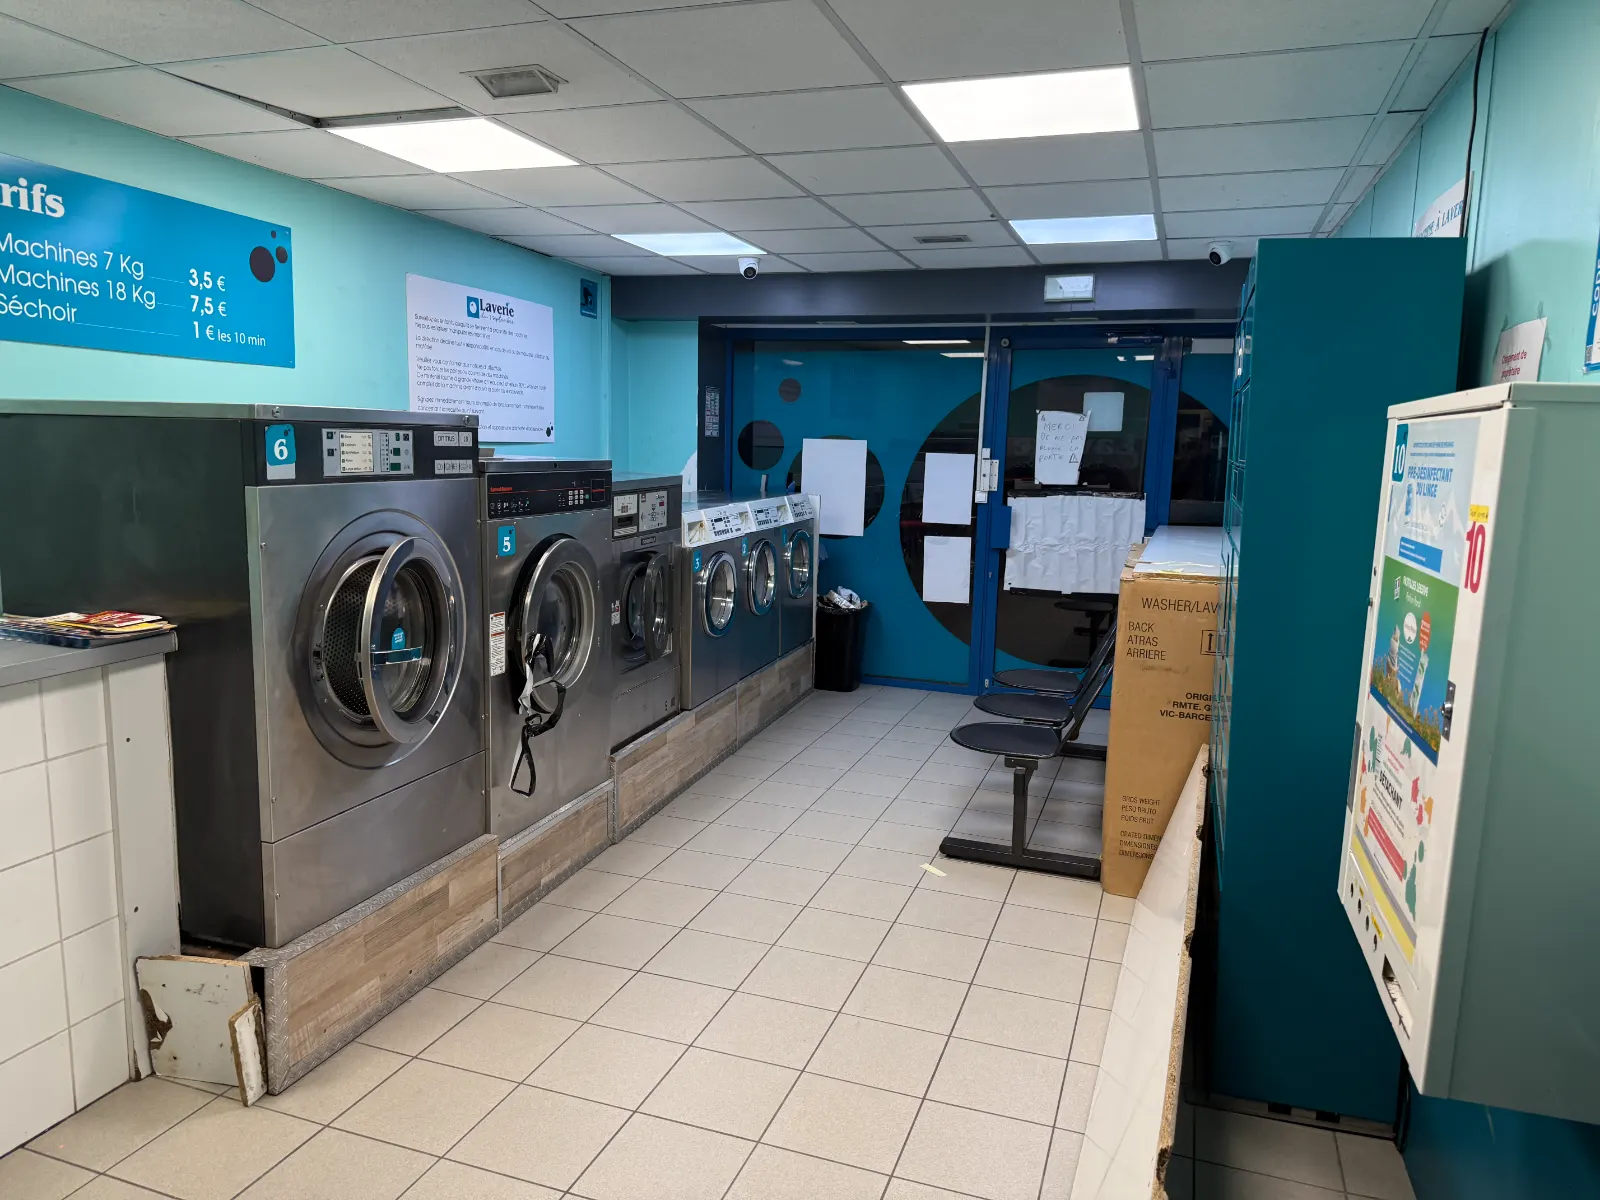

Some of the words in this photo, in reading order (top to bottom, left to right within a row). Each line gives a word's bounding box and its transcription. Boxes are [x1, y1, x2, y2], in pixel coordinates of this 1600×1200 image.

[0, 232, 98, 269] Machines
[103, 251, 113, 270] 7
[120, 255, 144, 281] Kg
[0, 264, 99, 297] Machines
[107, 280, 127, 302] 18
[132, 285, 156, 310] Kg
[188, 268, 213, 291] 3,5
[216, 276, 226, 292] €
[0, 293, 77, 324] Séchoir
[190, 294, 214, 316] 7,5
[218, 302, 227, 317] €
[480, 298, 515, 318] Laverie
[192, 321, 200, 339] 1
[206, 325, 215, 341] €
[217, 329, 232, 343] les
[234, 331, 246, 344] 10
[248, 334, 267, 347] min
[273, 438, 289, 460] 6
[1393, 443, 1406, 474] 10
[502, 537, 511, 552] 5
[1465, 520, 1486, 594] 10
[1128, 621, 1154, 633] BACK
[1127, 635, 1158, 647] ATRAS
[1126, 648, 1166, 660] ARRIERE
[1160, 709, 1213, 722] VIC-BARCE
[1172, 701, 1201, 711] RMTE.
[1379, 770, 1403, 811] DÉTACHANT
[1121, 805, 1136, 813] PESO
[1138, 807, 1157, 815] BRUTO
[1139, 798, 1160, 806] WEIGHT
[1120, 831, 1141, 839] CRATED
